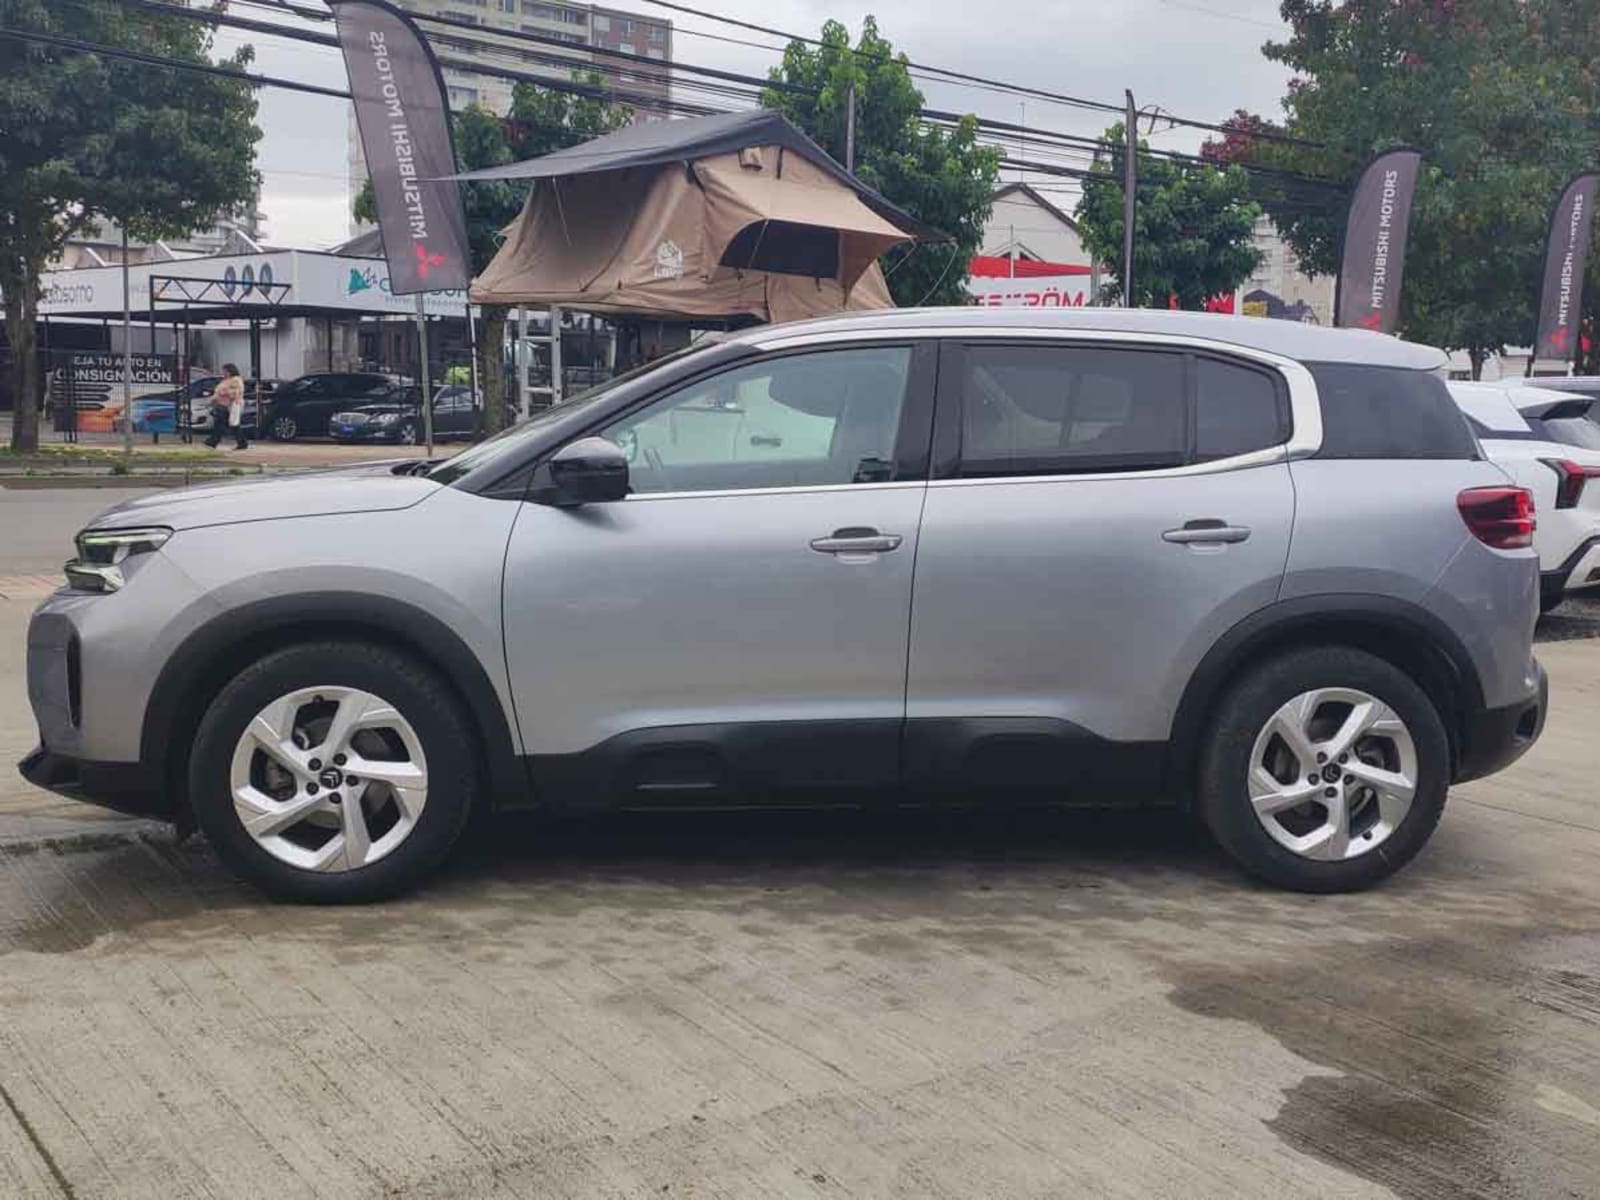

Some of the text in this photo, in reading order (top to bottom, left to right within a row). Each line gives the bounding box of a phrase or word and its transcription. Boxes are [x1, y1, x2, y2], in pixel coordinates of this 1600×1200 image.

[1371, 170, 1398, 309] MITSUBISHI MOTORS
[1558, 252, 1574, 326] MITSUBISHI
[55, 368, 172, 382] CNSIGNACIÓN
[97, 357, 112, 367] TU
[147, 357, 162, 367] EN
